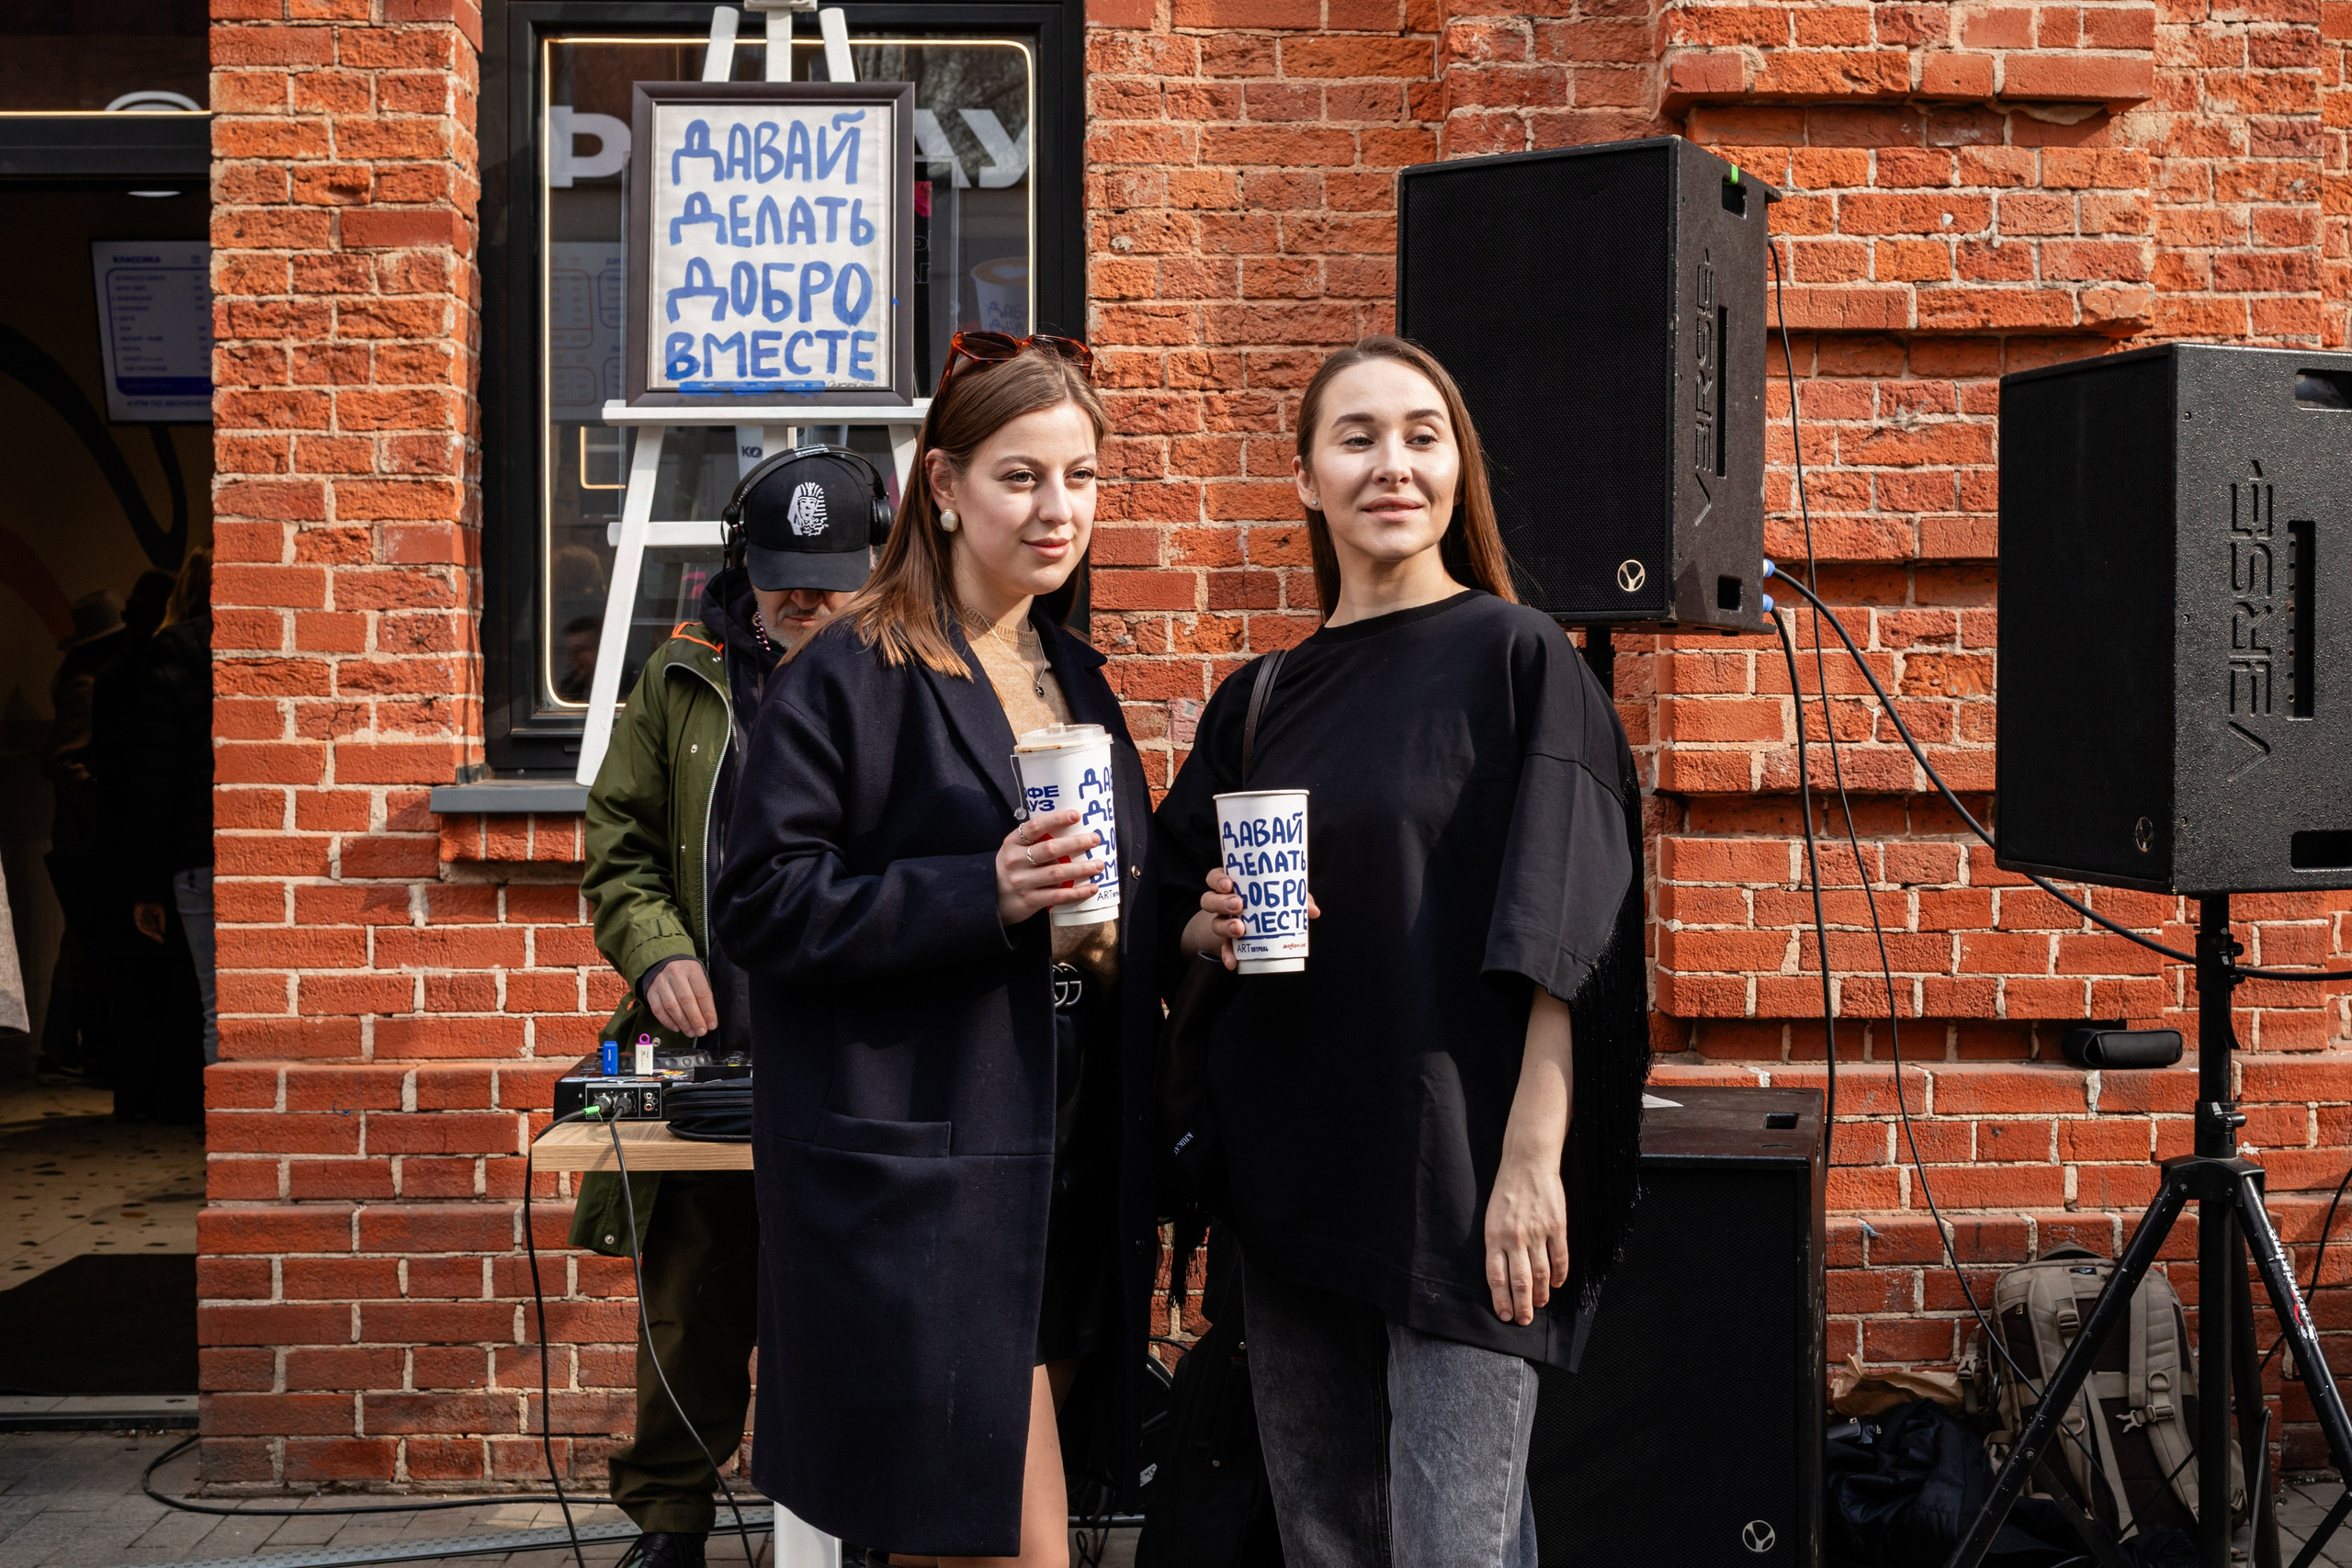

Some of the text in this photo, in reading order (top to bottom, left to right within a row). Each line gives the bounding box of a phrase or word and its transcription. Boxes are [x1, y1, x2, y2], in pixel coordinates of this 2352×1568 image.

[672, 108, 866, 186] ДАВАЙ
[669, 190, 876, 247] ДЕЛАТЬ
[666, 256, 874, 328] ДОБРО
[665, 330, 877, 380] ВМЕСТЕ
[1023, 784, 1060, 799] ФЕ
[1222, 811, 1303, 852] ДАВАЙ
[1226, 851, 1306, 875] ДЕЛАТЬ
[1232, 908, 1307, 934] МЕСТЕ
